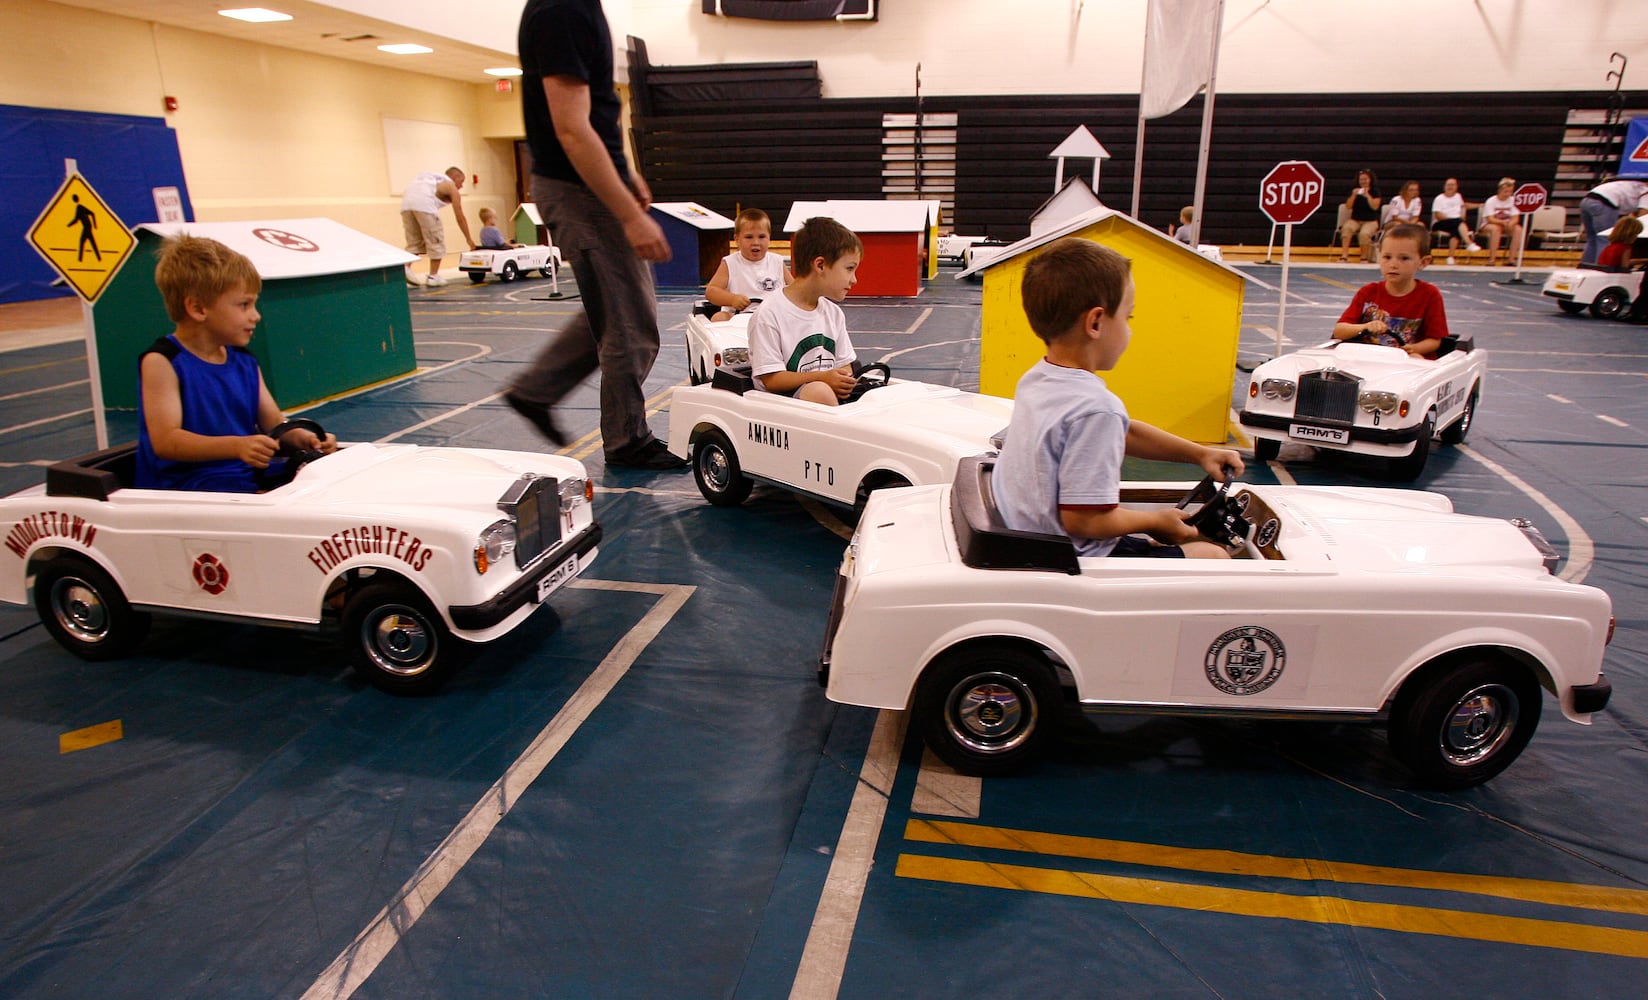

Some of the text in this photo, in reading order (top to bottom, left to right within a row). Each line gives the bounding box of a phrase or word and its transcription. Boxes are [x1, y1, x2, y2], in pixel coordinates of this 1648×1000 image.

[1265, 181, 1319, 206] STOP
[1515, 193, 1545, 206] STOP
[1373, 409, 1381, 426] 6
[748, 421, 789, 451] AMANDA
[4, 510, 97, 560] MIDDLETOWN
[307, 525, 432, 576] FIREFIGHTERS
